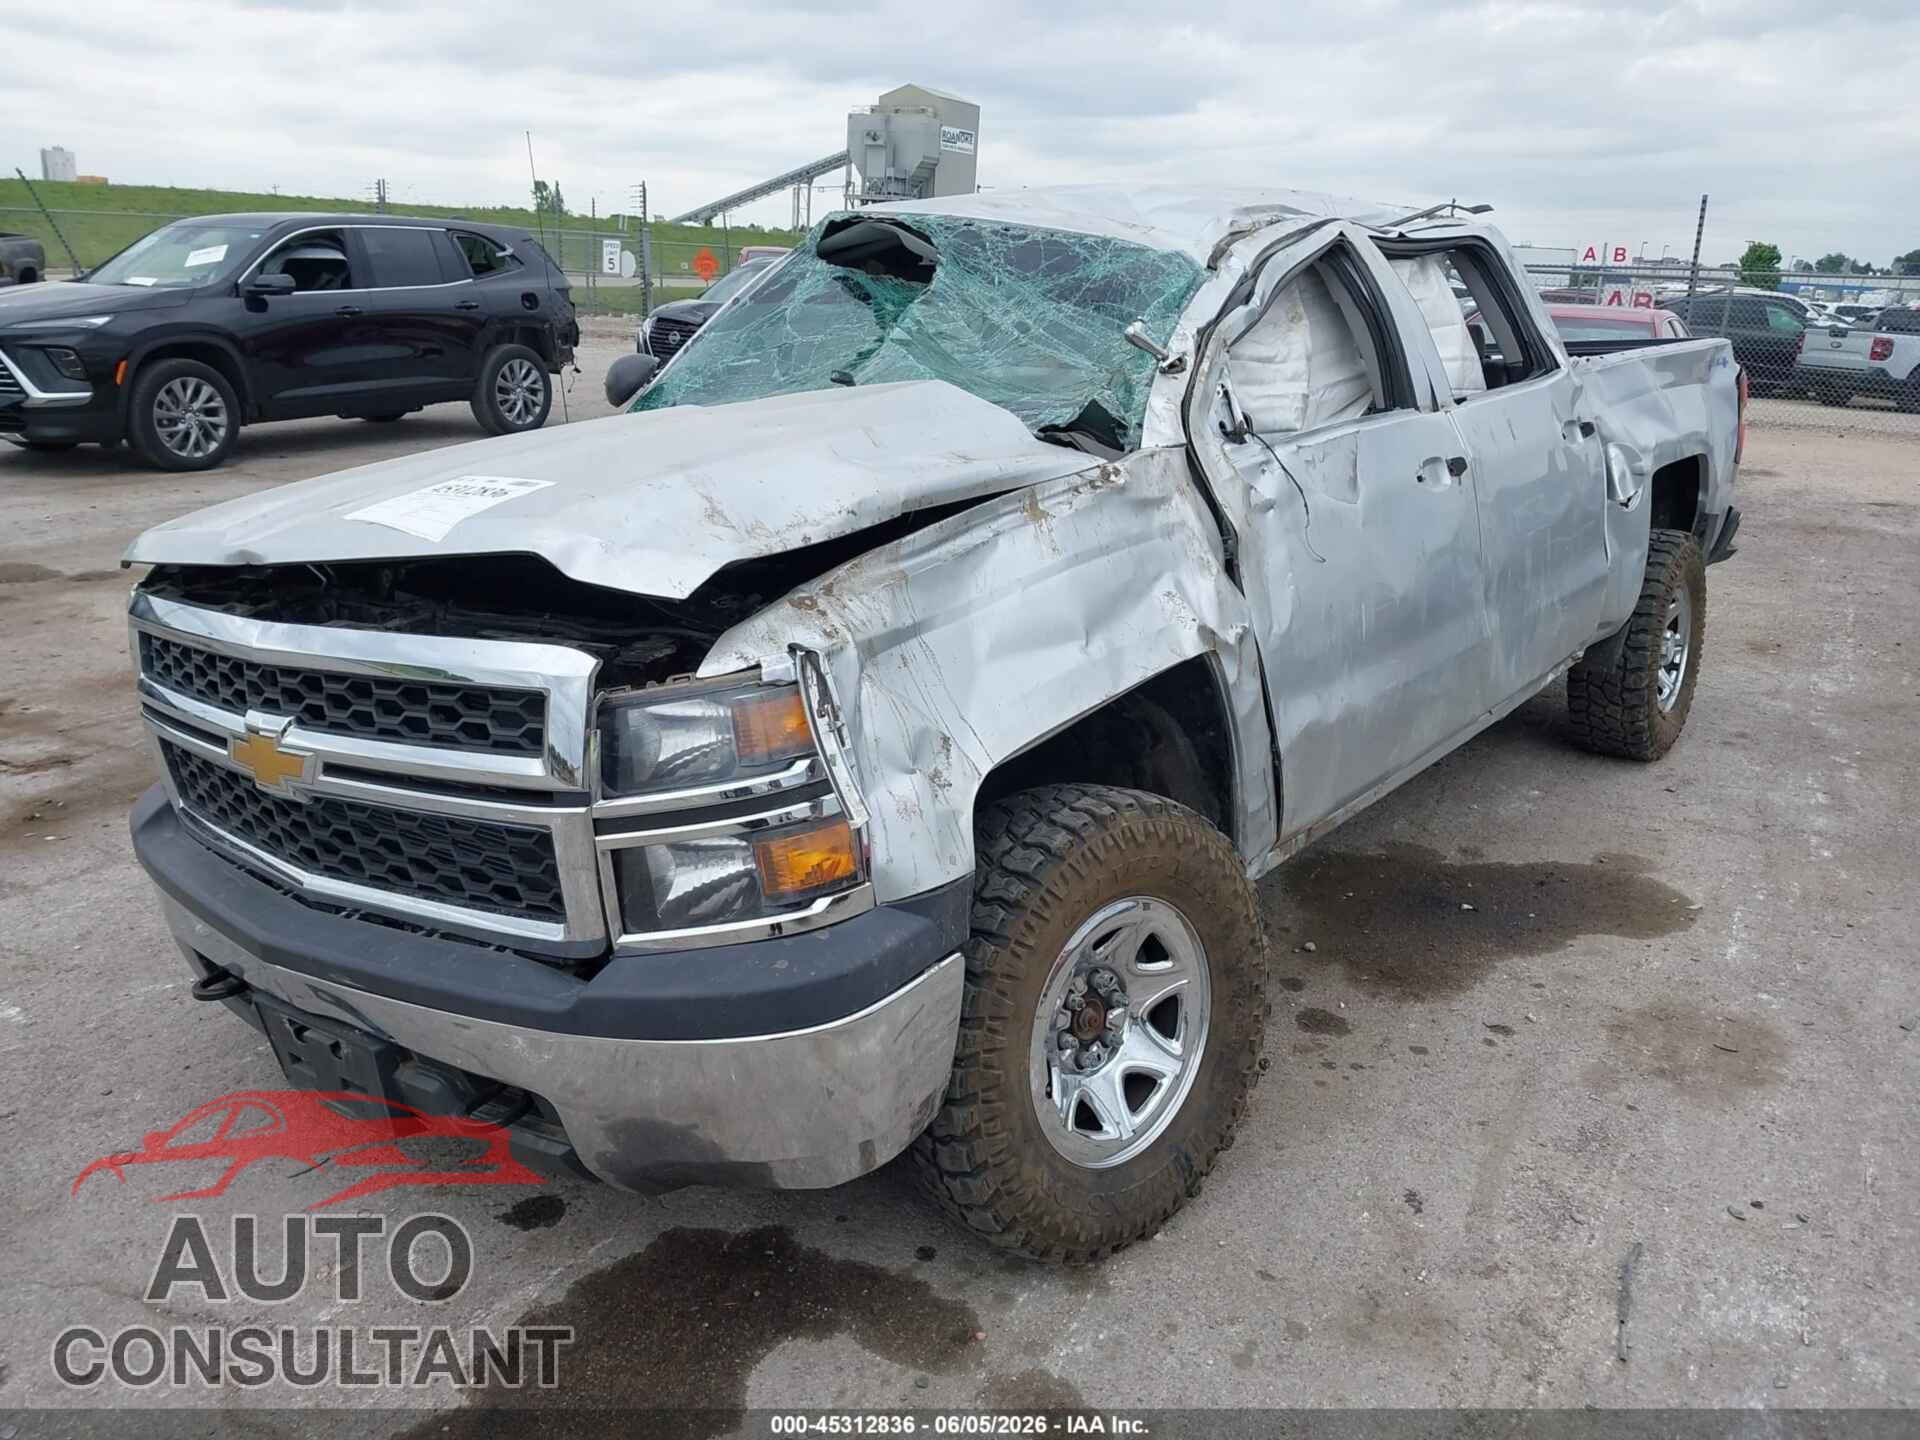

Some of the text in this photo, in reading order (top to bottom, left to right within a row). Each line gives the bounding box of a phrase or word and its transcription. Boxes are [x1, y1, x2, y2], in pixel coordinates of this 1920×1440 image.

[1583, 247, 1627, 262] A B
[608, 257, 616, 271] 5
[1607, 290, 1623, 306] A
